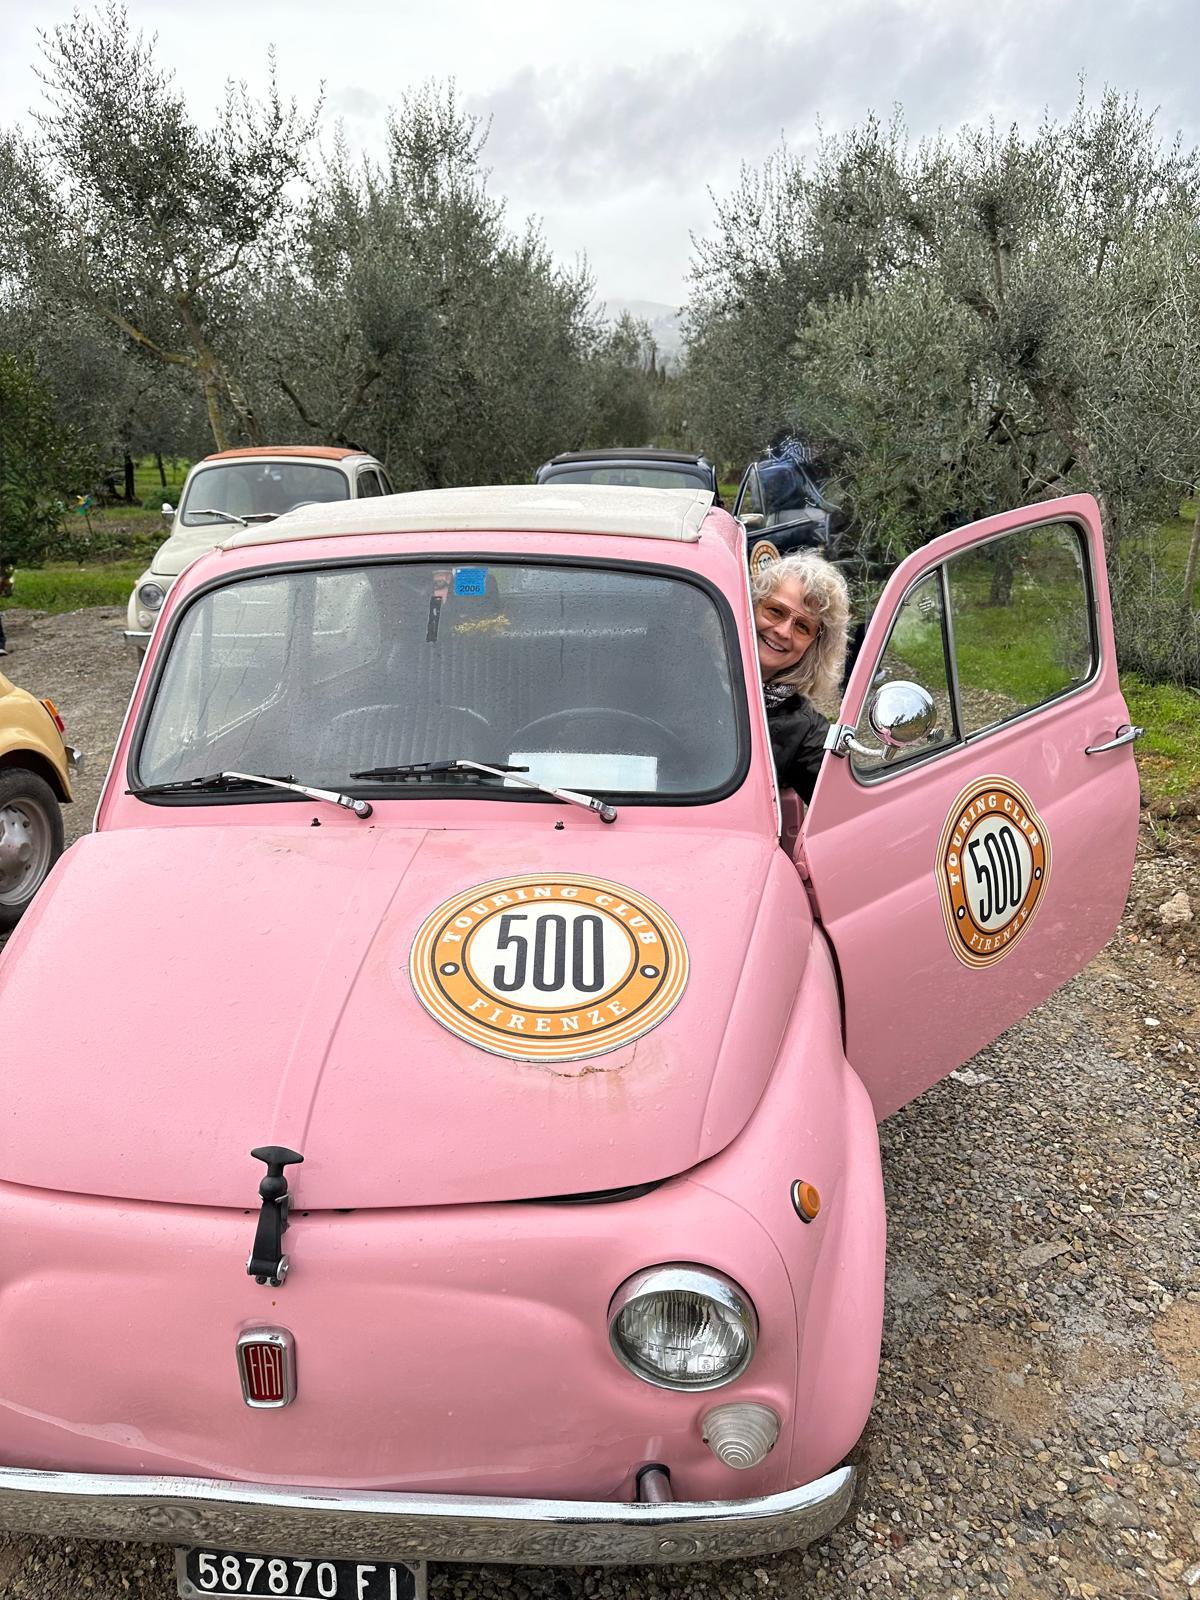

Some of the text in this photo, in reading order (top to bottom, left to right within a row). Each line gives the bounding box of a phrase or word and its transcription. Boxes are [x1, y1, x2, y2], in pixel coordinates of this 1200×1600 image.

[948, 794, 1040, 887] TOURING CLUB
[968, 825, 1022, 923] 500
[442, 886, 658, 945] TOURING CLUB
[969, 906, 1029, 951] FIRENZE
[493, 914, 605, 993] 500
[467, 998, 628, 1032] FIRENZE
[249, 1346, 281, 1396] FIAT
[199, 1553, 338, 1598] 587870
